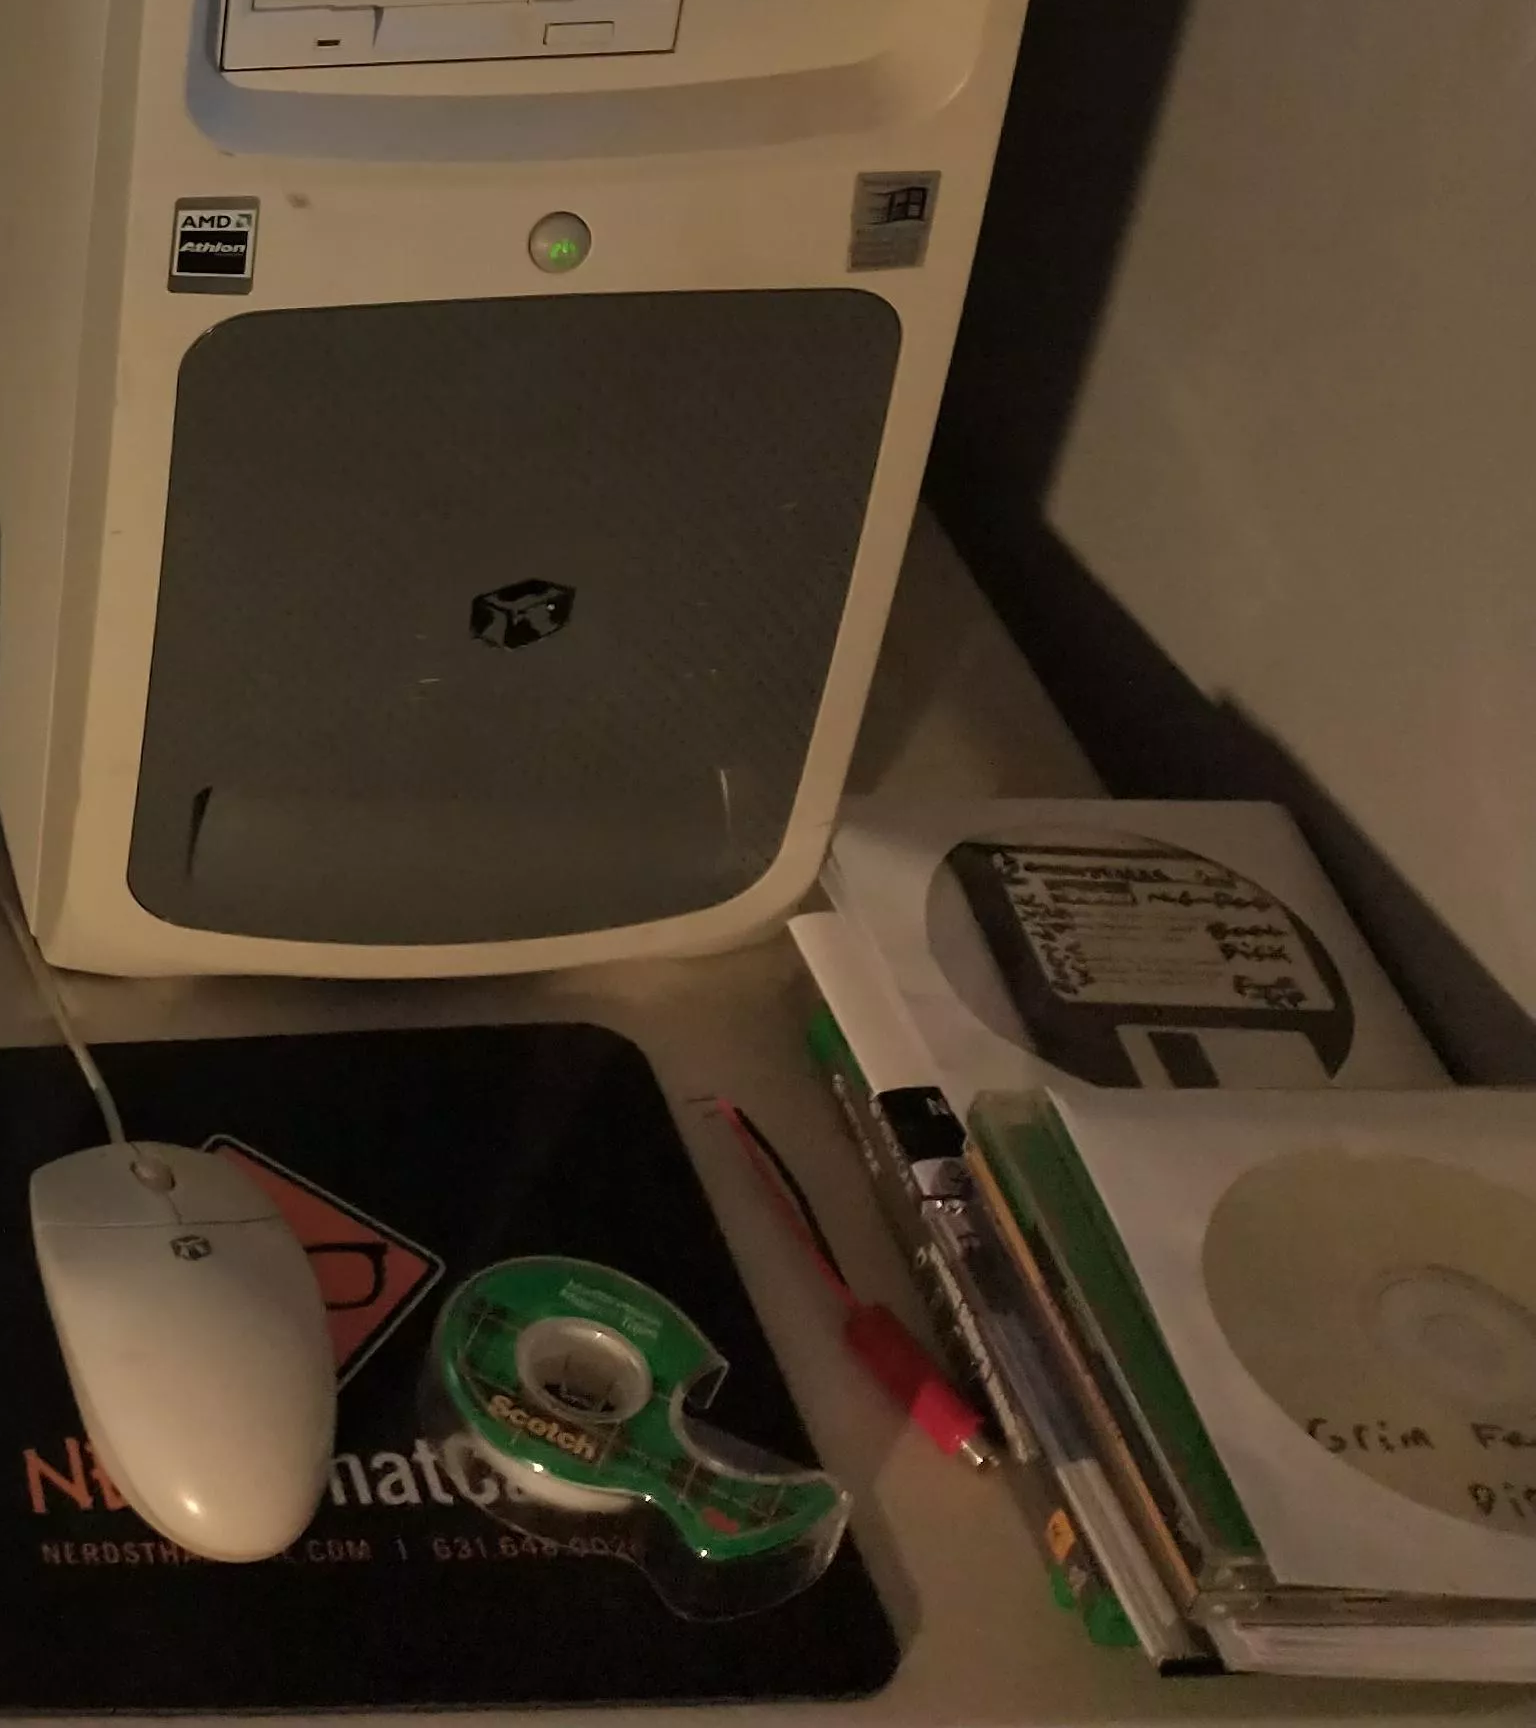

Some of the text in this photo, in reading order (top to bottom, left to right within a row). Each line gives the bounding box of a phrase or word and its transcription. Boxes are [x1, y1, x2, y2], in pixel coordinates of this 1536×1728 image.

[180, 215, 232, 228] AMD
[487, 1393, 598, 1463] Scotch
[1306, 1416, 1436, 1455] Grim
